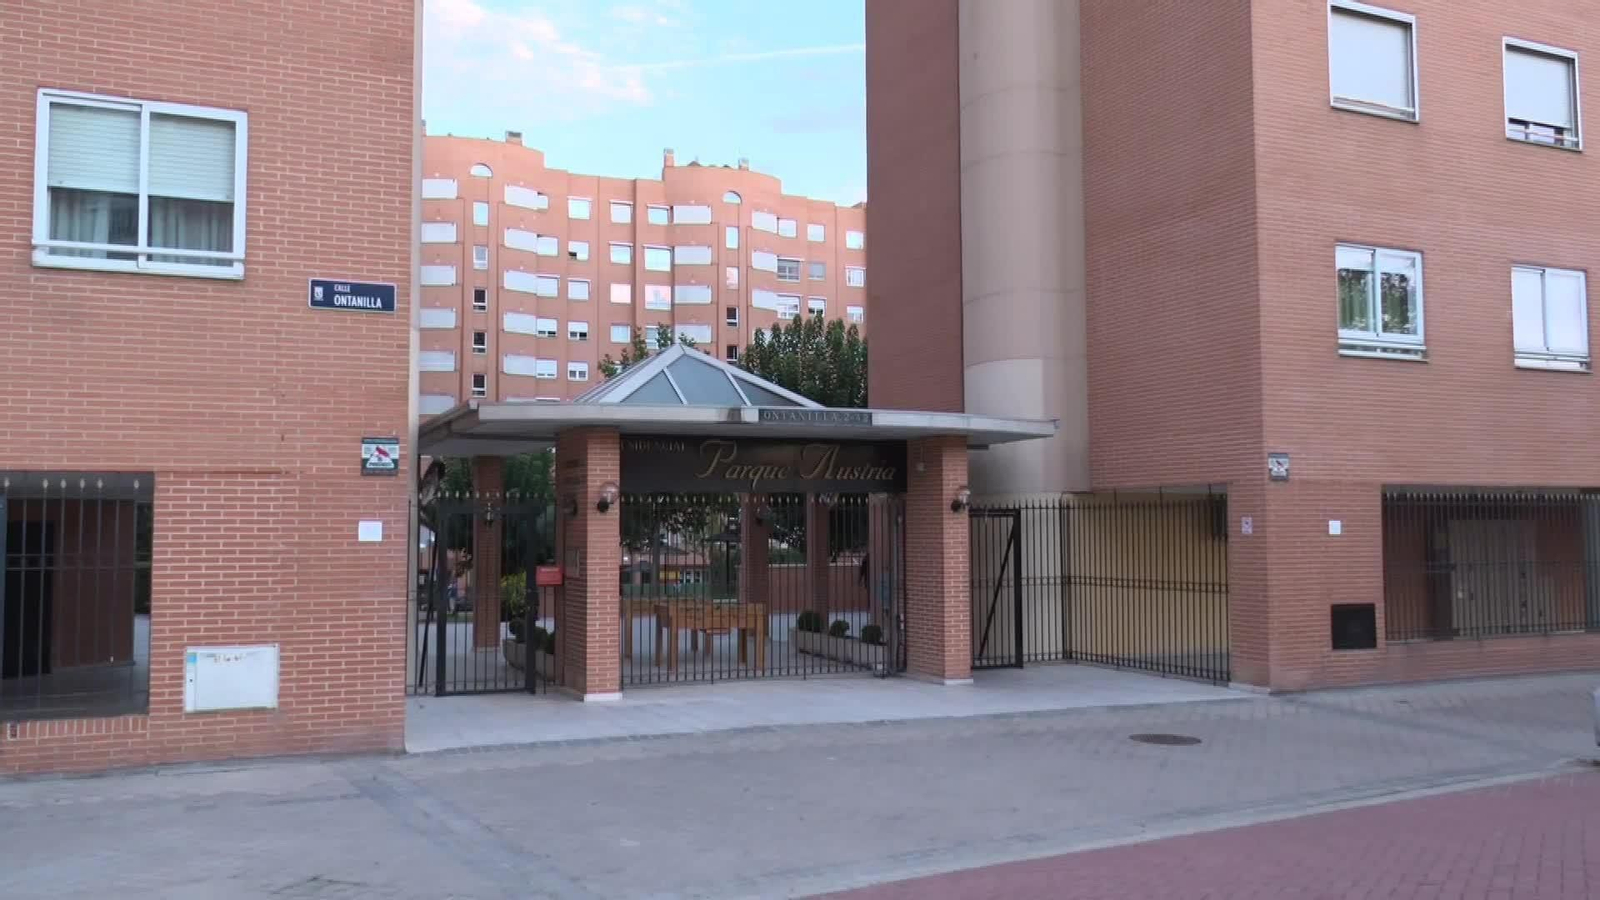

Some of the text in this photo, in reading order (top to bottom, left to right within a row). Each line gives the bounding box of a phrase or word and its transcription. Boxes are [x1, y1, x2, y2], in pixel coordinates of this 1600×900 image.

[334, 284, 351, 292] CALLE
[333, 295, 382, 309] ONTANILLA
[763, 410, 839, 421] ONTANILLA
[694, 440, 895, 490] Parque Austria
